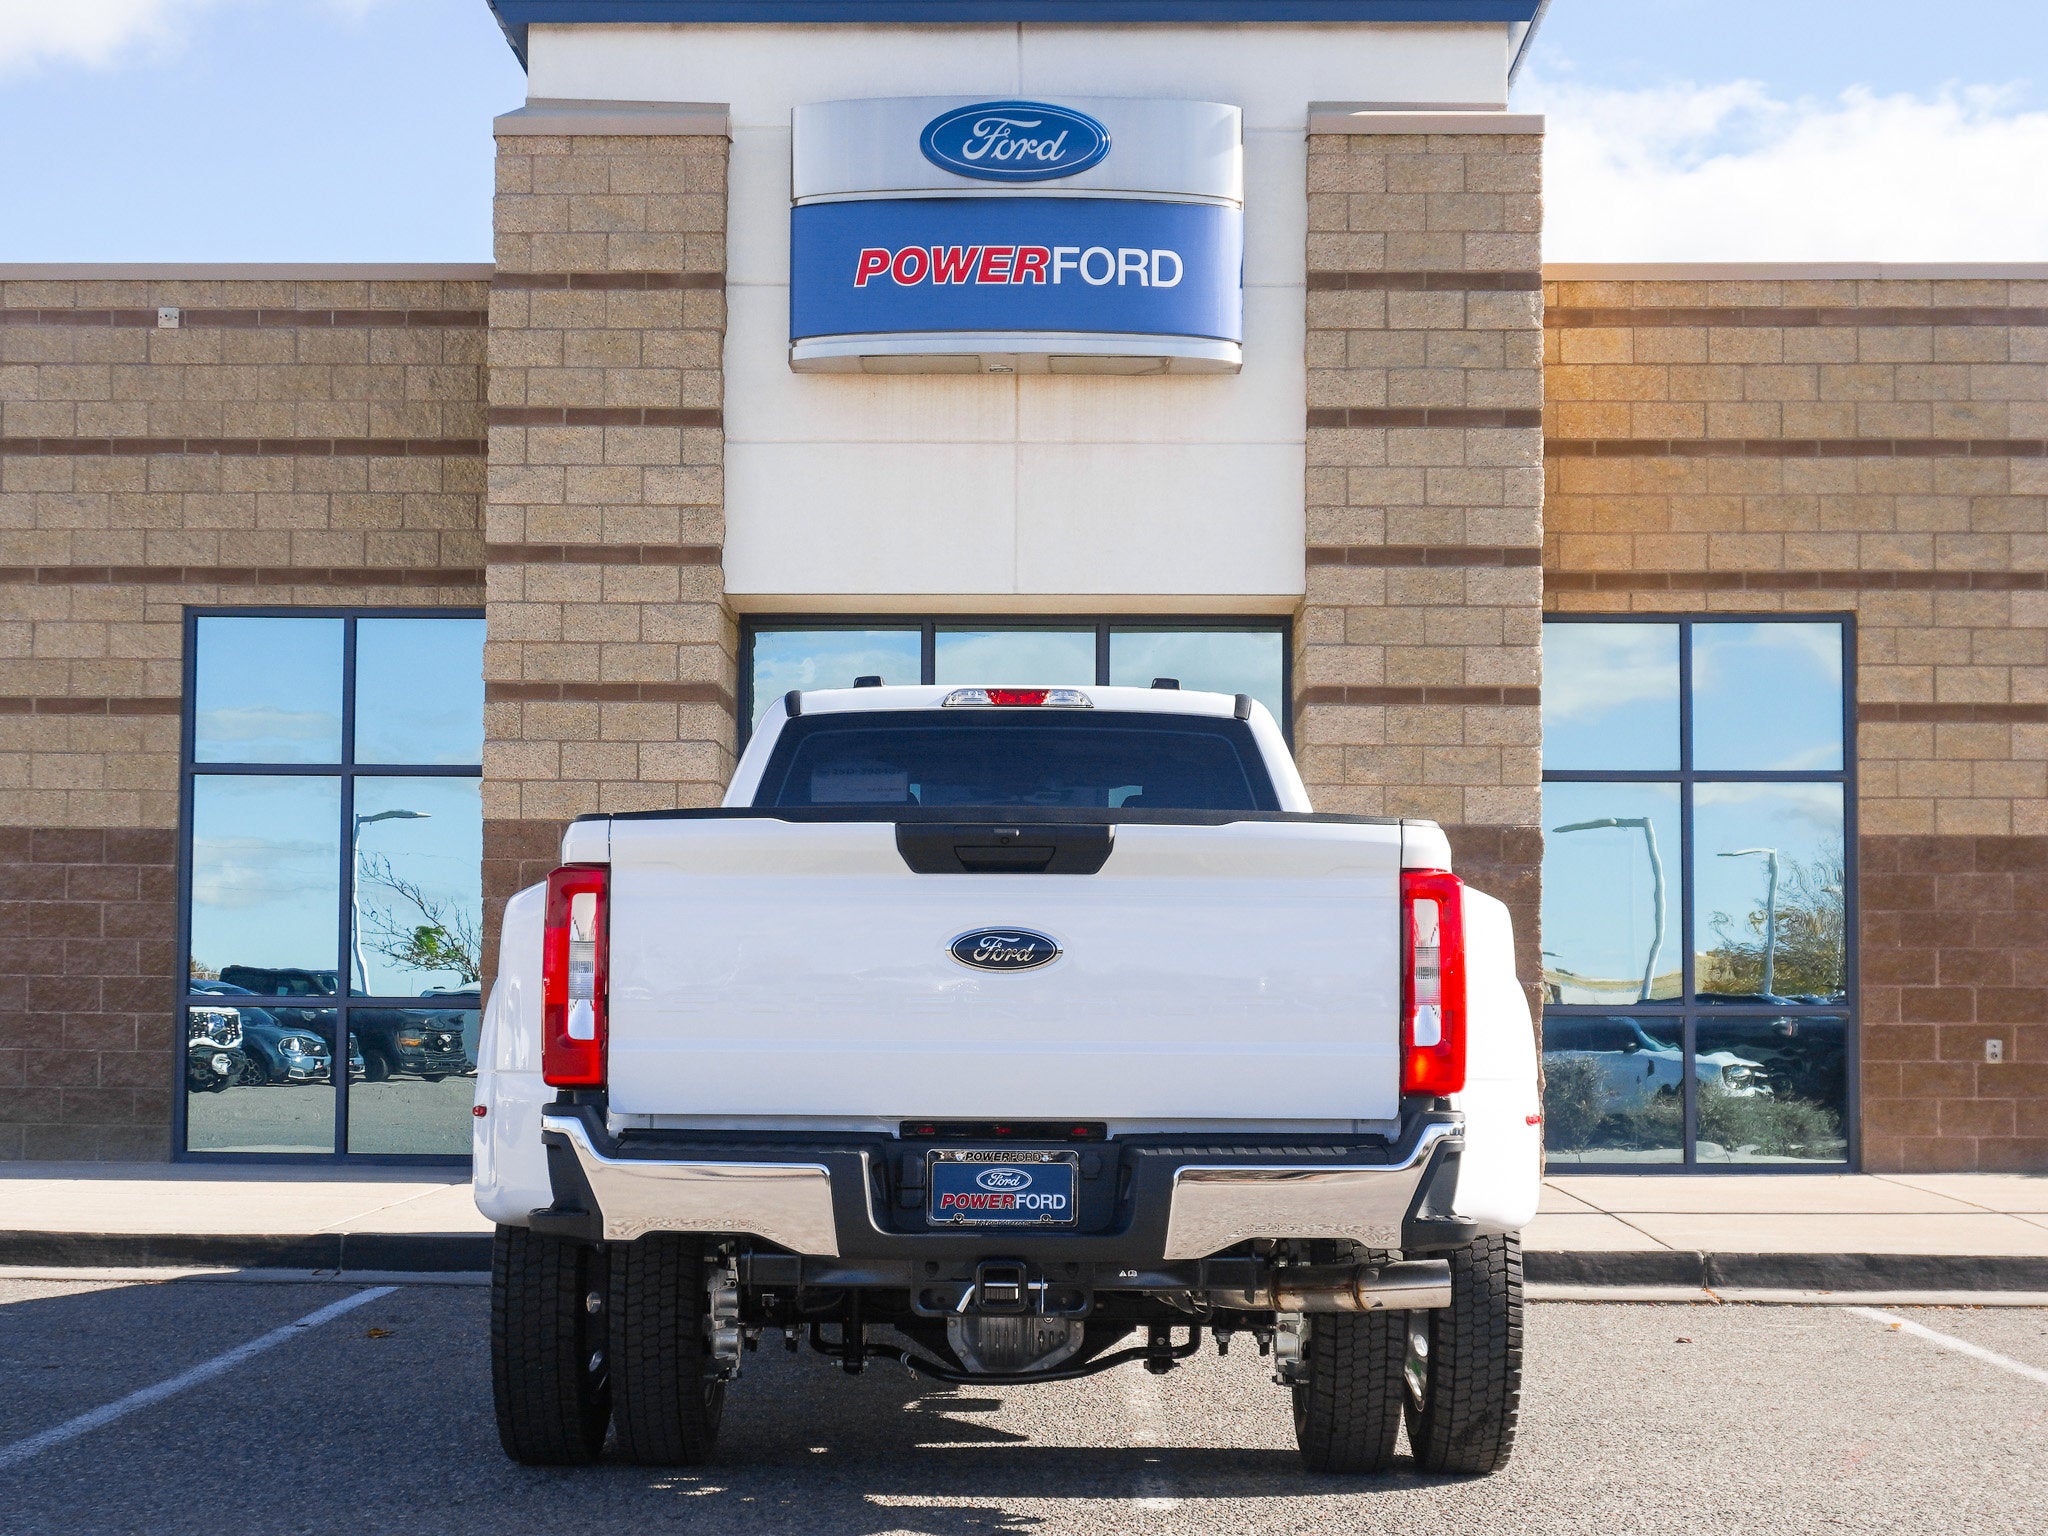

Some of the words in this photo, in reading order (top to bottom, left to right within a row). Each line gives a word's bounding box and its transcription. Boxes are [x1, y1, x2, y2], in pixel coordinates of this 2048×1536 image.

[962, 117, 1069, 162] Ford
[854, 246, 1184, 288] POWERFORD
[973, 935, 1036, 962] Ford
[965, 1152, 1042, 1162] POWERFORD
[987, 1172, 1021, 1187] Ford
[940, 1193, 1067, 1210] POWERFORD
